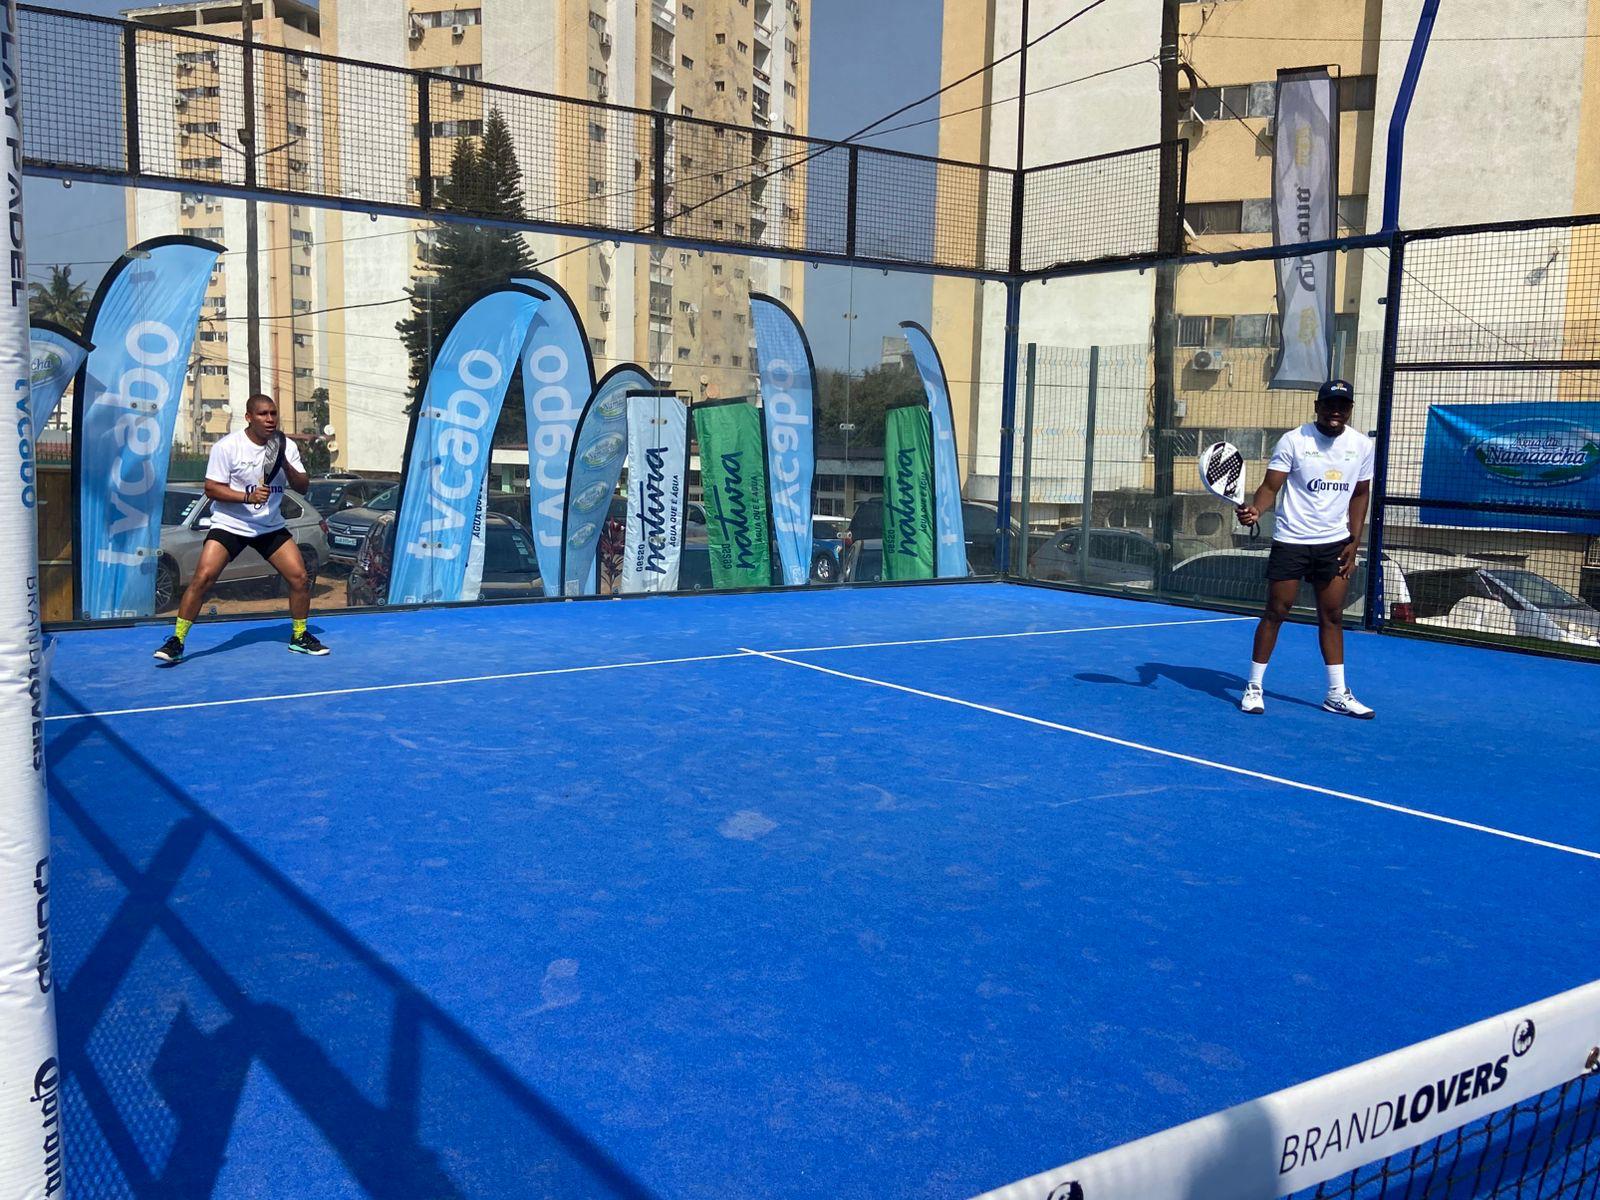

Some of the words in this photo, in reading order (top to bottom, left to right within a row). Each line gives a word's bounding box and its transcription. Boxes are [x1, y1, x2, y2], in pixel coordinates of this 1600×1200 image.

[0, 0, 20, 128] PLAY
[6, 136, 25, 307] PADEL
[97, 321, 179, 567] tvcabo
[406, 349, 501, 560] tvcabo
[885, 447, 918, 558] natura
[1307, 478, 1350, 493] Corona
[1485, 446, 1587, 465] Namaacha
[636, 446, 669, 574] natura
[670, 506, 678, 523] QUE
[712, 451, 756, 569] natura
[30, 1057, 61, 1198] Corona
[1279, 1054, 1510, 1175] BRANDLOVERS
